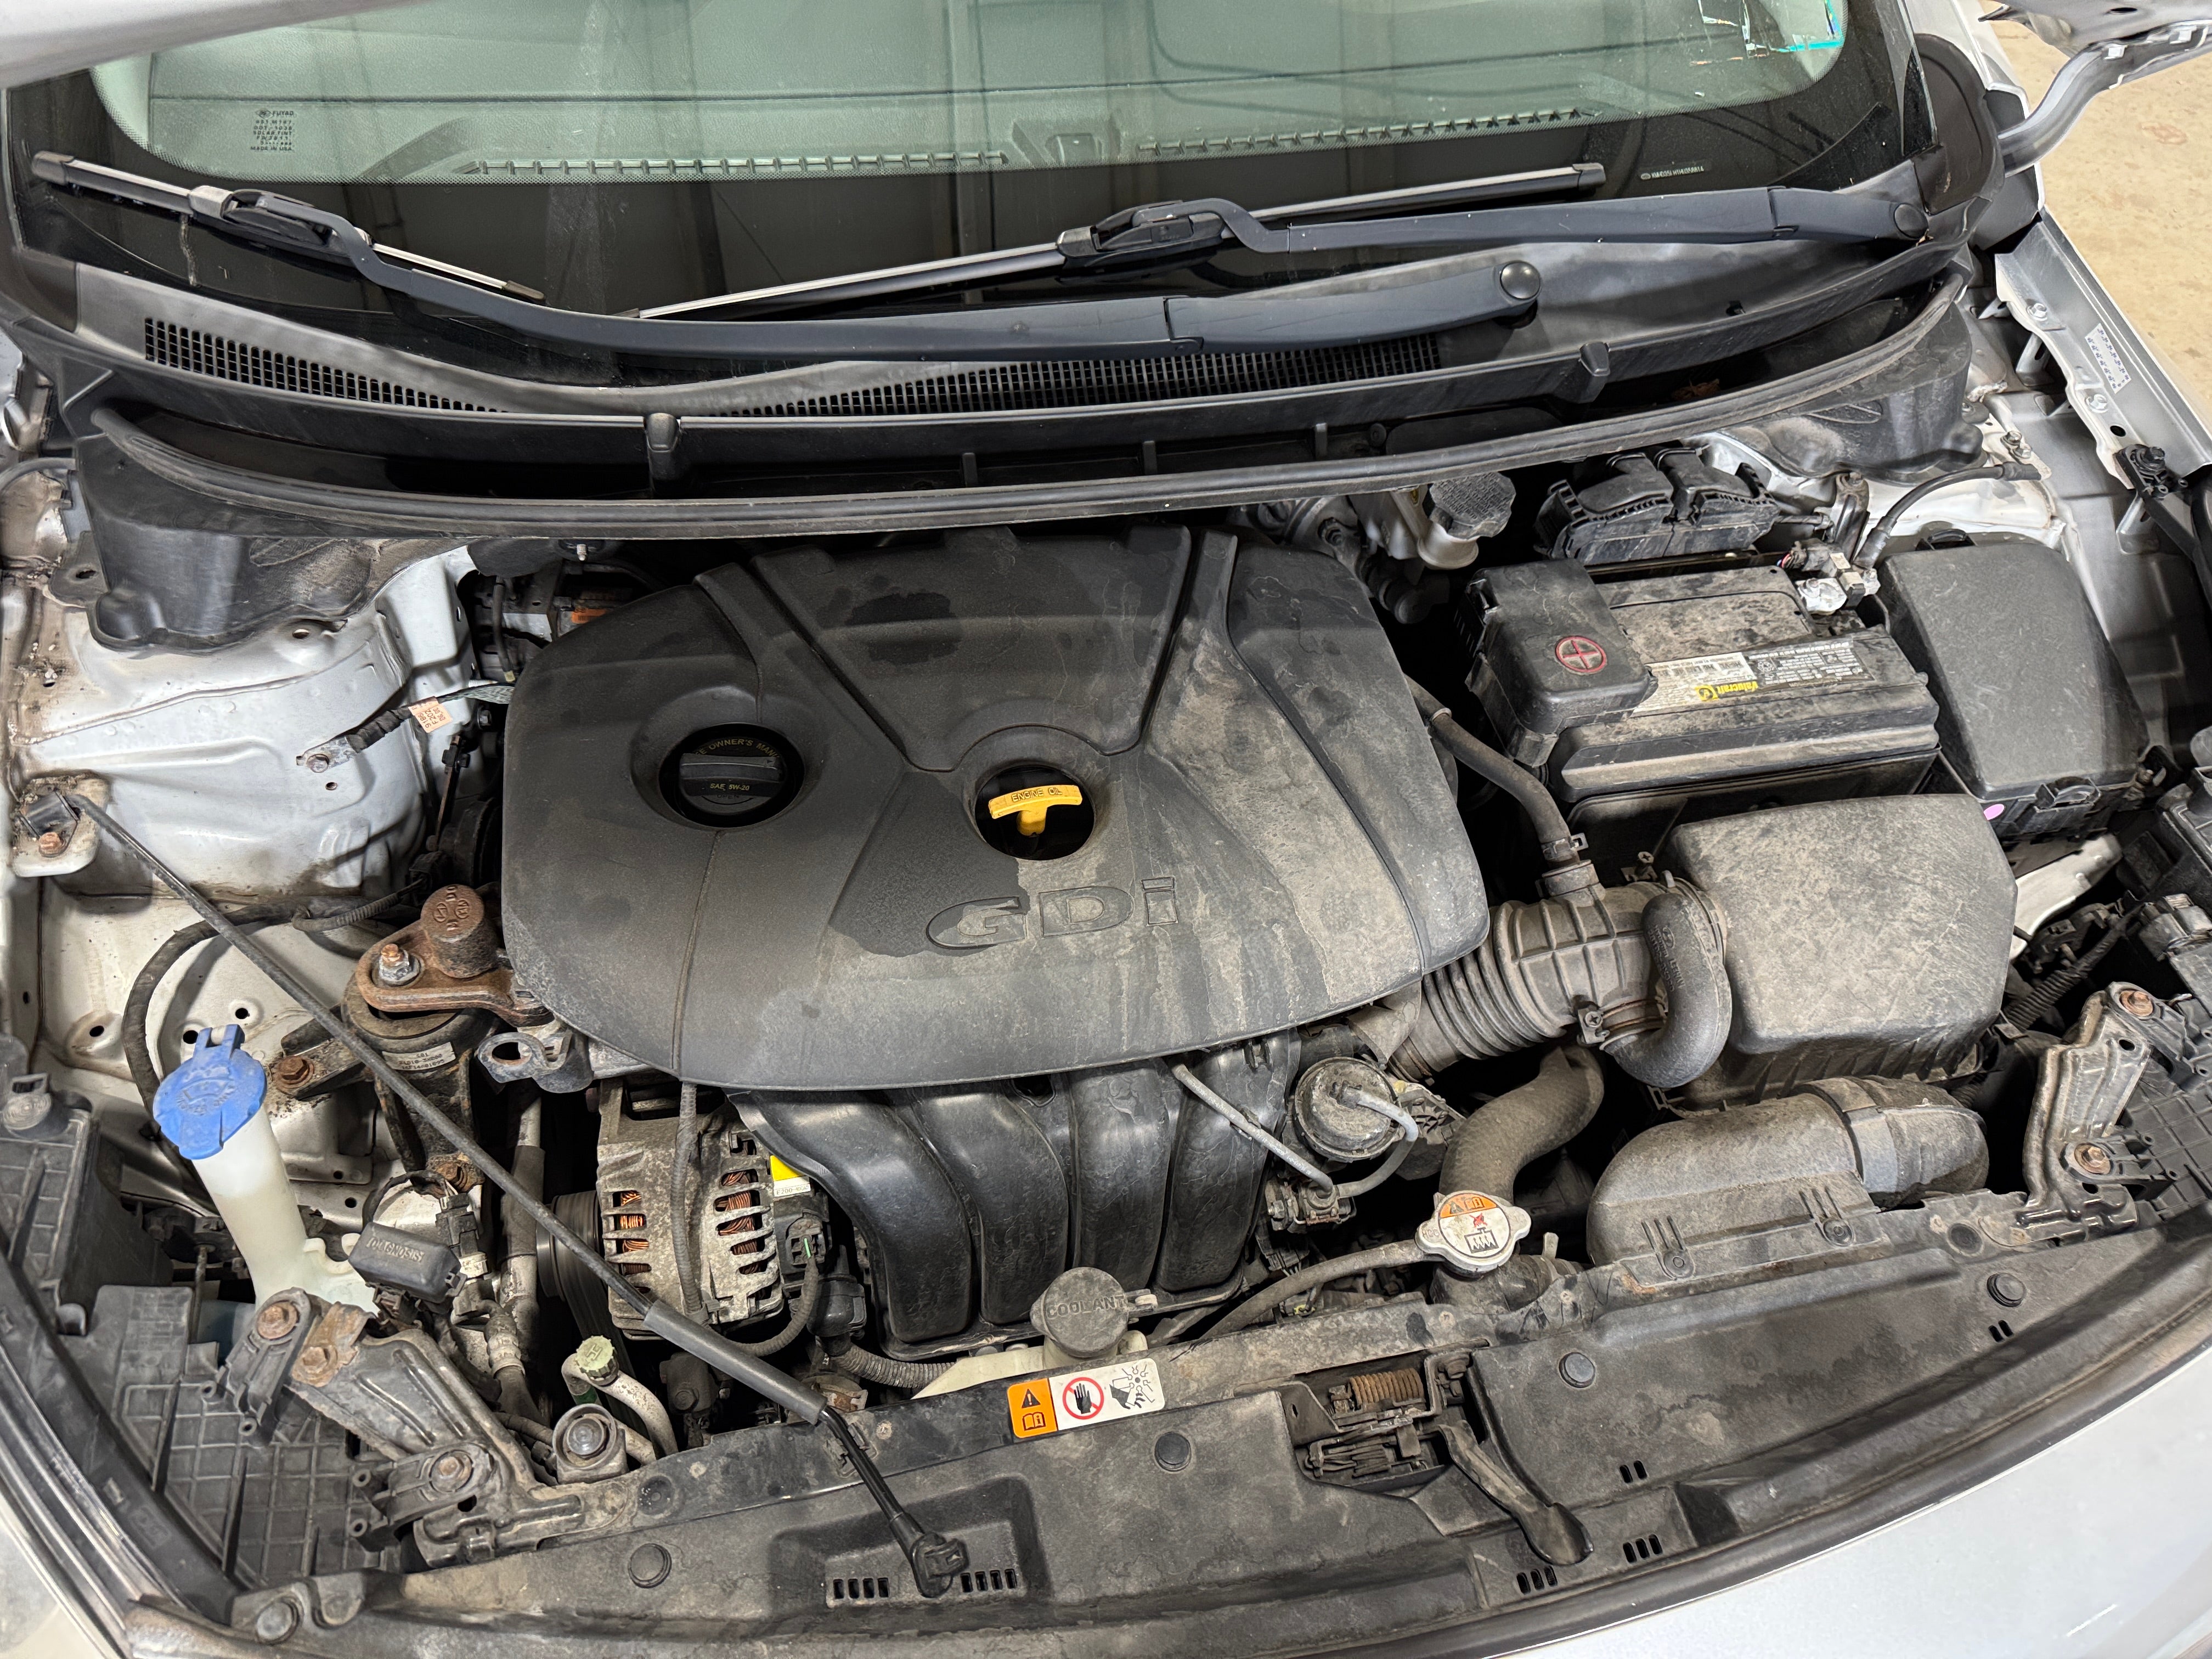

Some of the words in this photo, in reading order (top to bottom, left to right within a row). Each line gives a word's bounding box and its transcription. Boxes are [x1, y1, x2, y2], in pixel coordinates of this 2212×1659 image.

[708, 738, 754, 750] OWNER'S
[1011, 788, 1044, 803] ENGINE
[1048, 786, 1063, 797] OIL
[926, 876, 1179, 950] GDi
[1045, 1294, 1126, 1319] COOLANT
